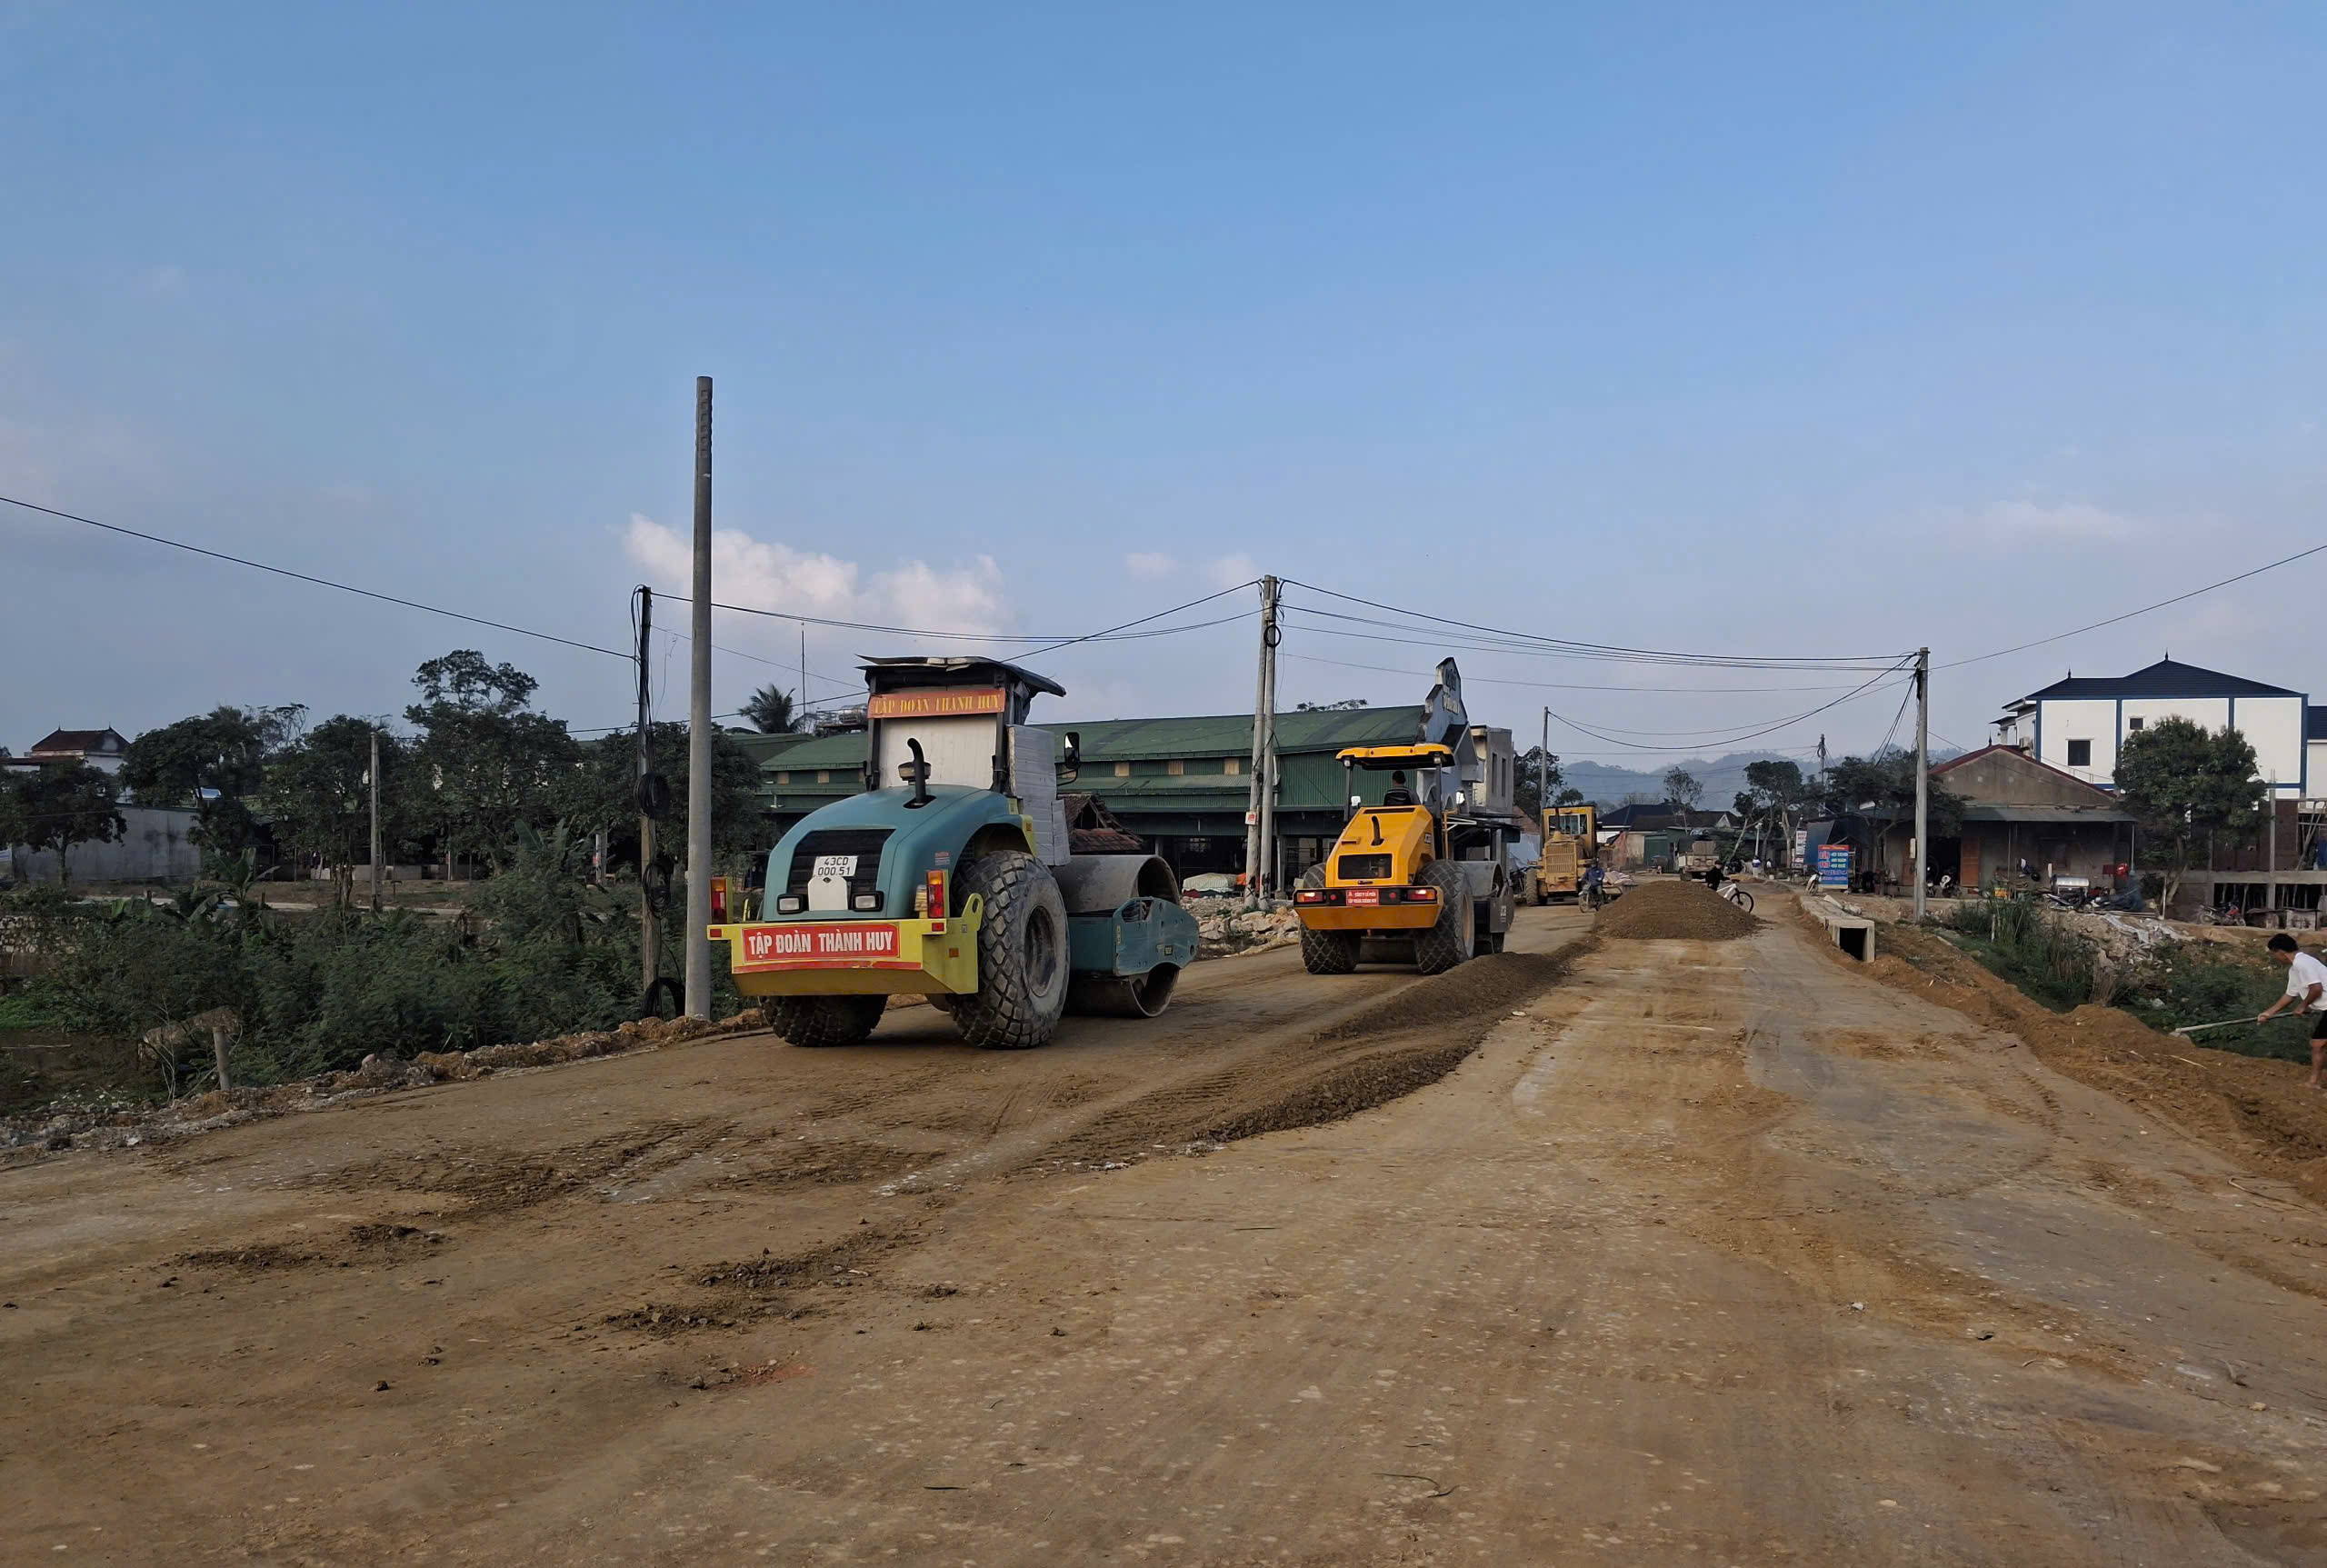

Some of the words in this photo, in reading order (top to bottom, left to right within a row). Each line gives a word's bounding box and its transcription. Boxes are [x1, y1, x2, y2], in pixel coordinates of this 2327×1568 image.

[978, 694, 1001, 710] HUY
[824, 857, 849, 866] 43CD
[748, 932, 773, 959] TẬP
[775, 929, 812, 954] ĐOÀN
[818, 929, 863, 953] THÀNH
[865, 931, 893, 951] HUY
